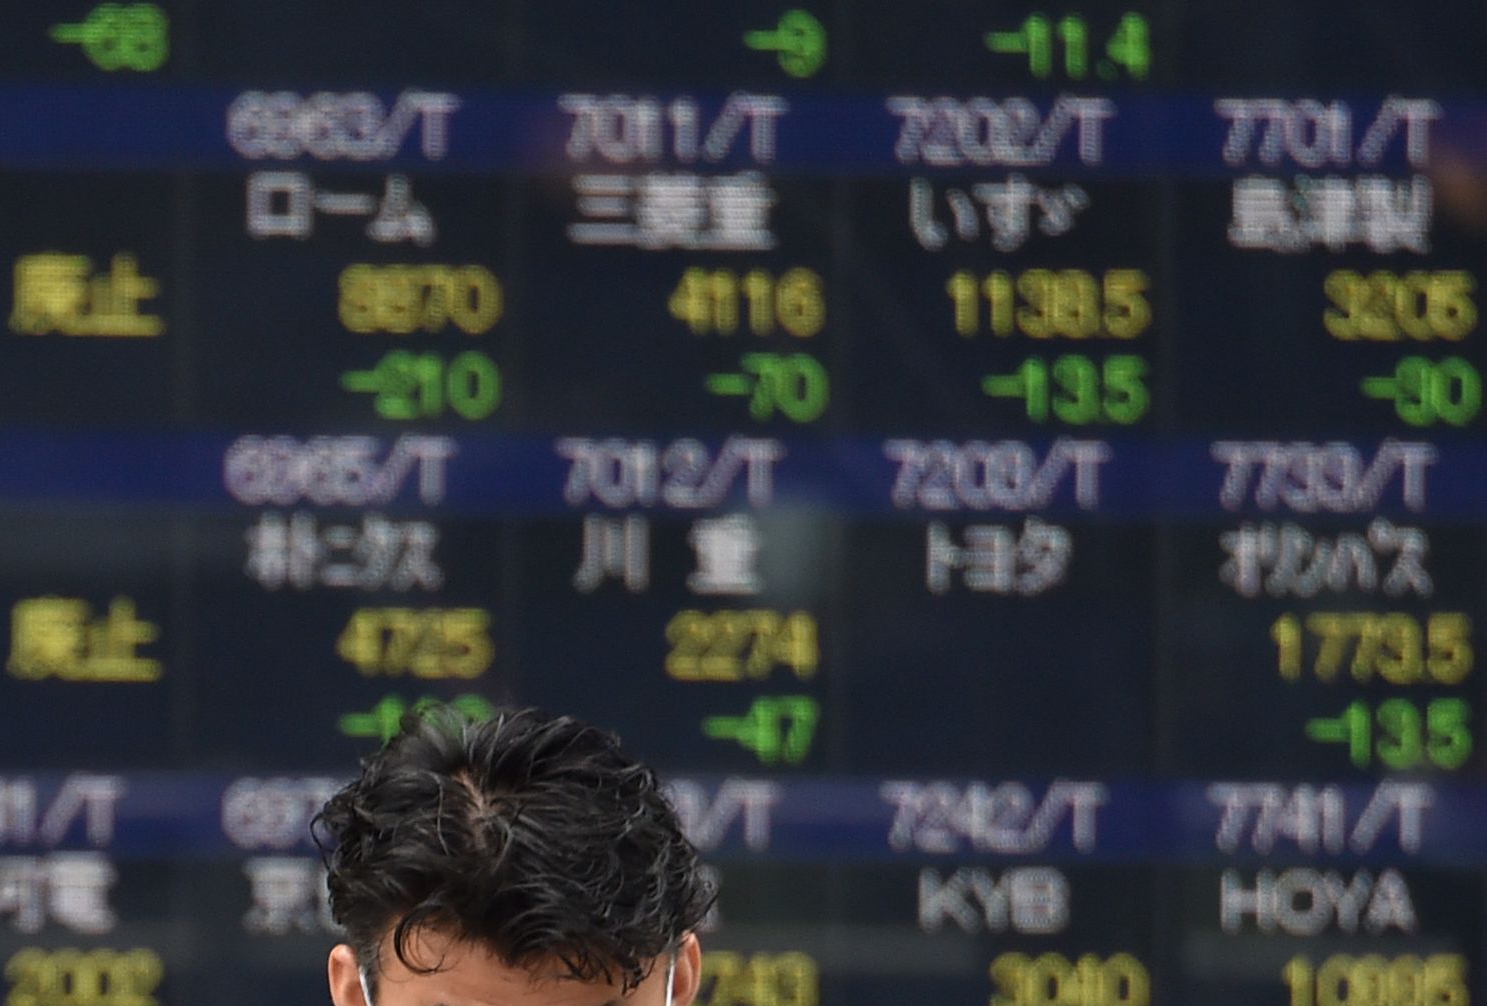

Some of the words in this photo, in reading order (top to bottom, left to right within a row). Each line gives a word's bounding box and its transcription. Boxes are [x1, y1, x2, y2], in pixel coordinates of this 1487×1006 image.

[559, 93, 783, 165] 7011/T
[247, 170, 434, 243] ローム
[669, 268, 825, 337] 4116
[558, 437, 785, 508] 7012/T
[885, 439, 1107, 510] 7203/T
[927, 519, 1071, 593] トヨタ
[1207, 780, 1434, 848] 7741/T
[919, 867, 1067, 933] KYB
[1220, 868, 1414, 936] HOYA
